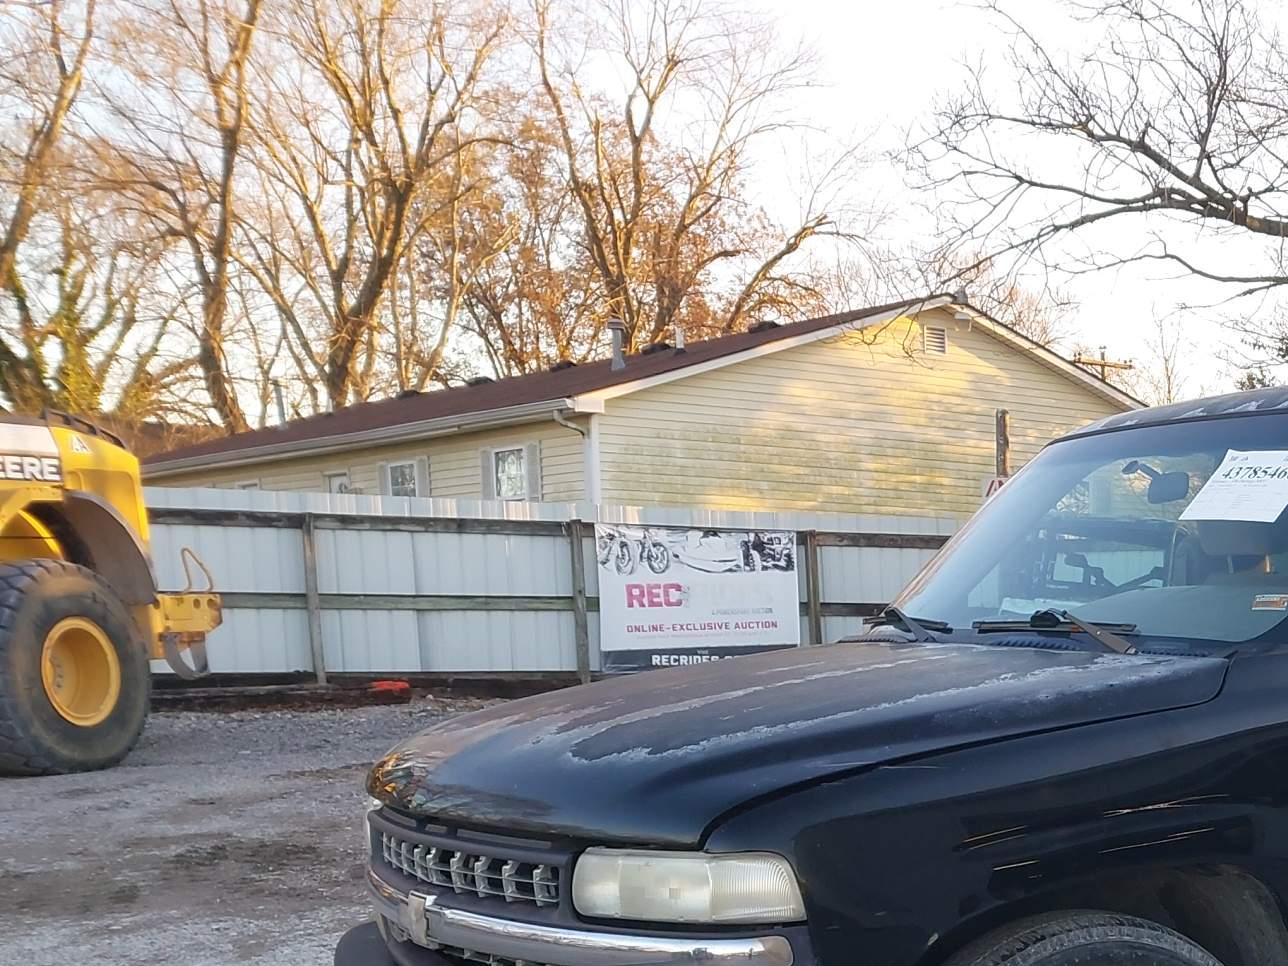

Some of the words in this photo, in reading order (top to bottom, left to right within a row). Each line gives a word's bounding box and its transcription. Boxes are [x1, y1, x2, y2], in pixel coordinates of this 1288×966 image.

[0, 455, 61, 480] ERE
[626, 621, 730, 633] ONLINE-EXCLUSIVE
[734, 620, 778, 630] AUCTION
